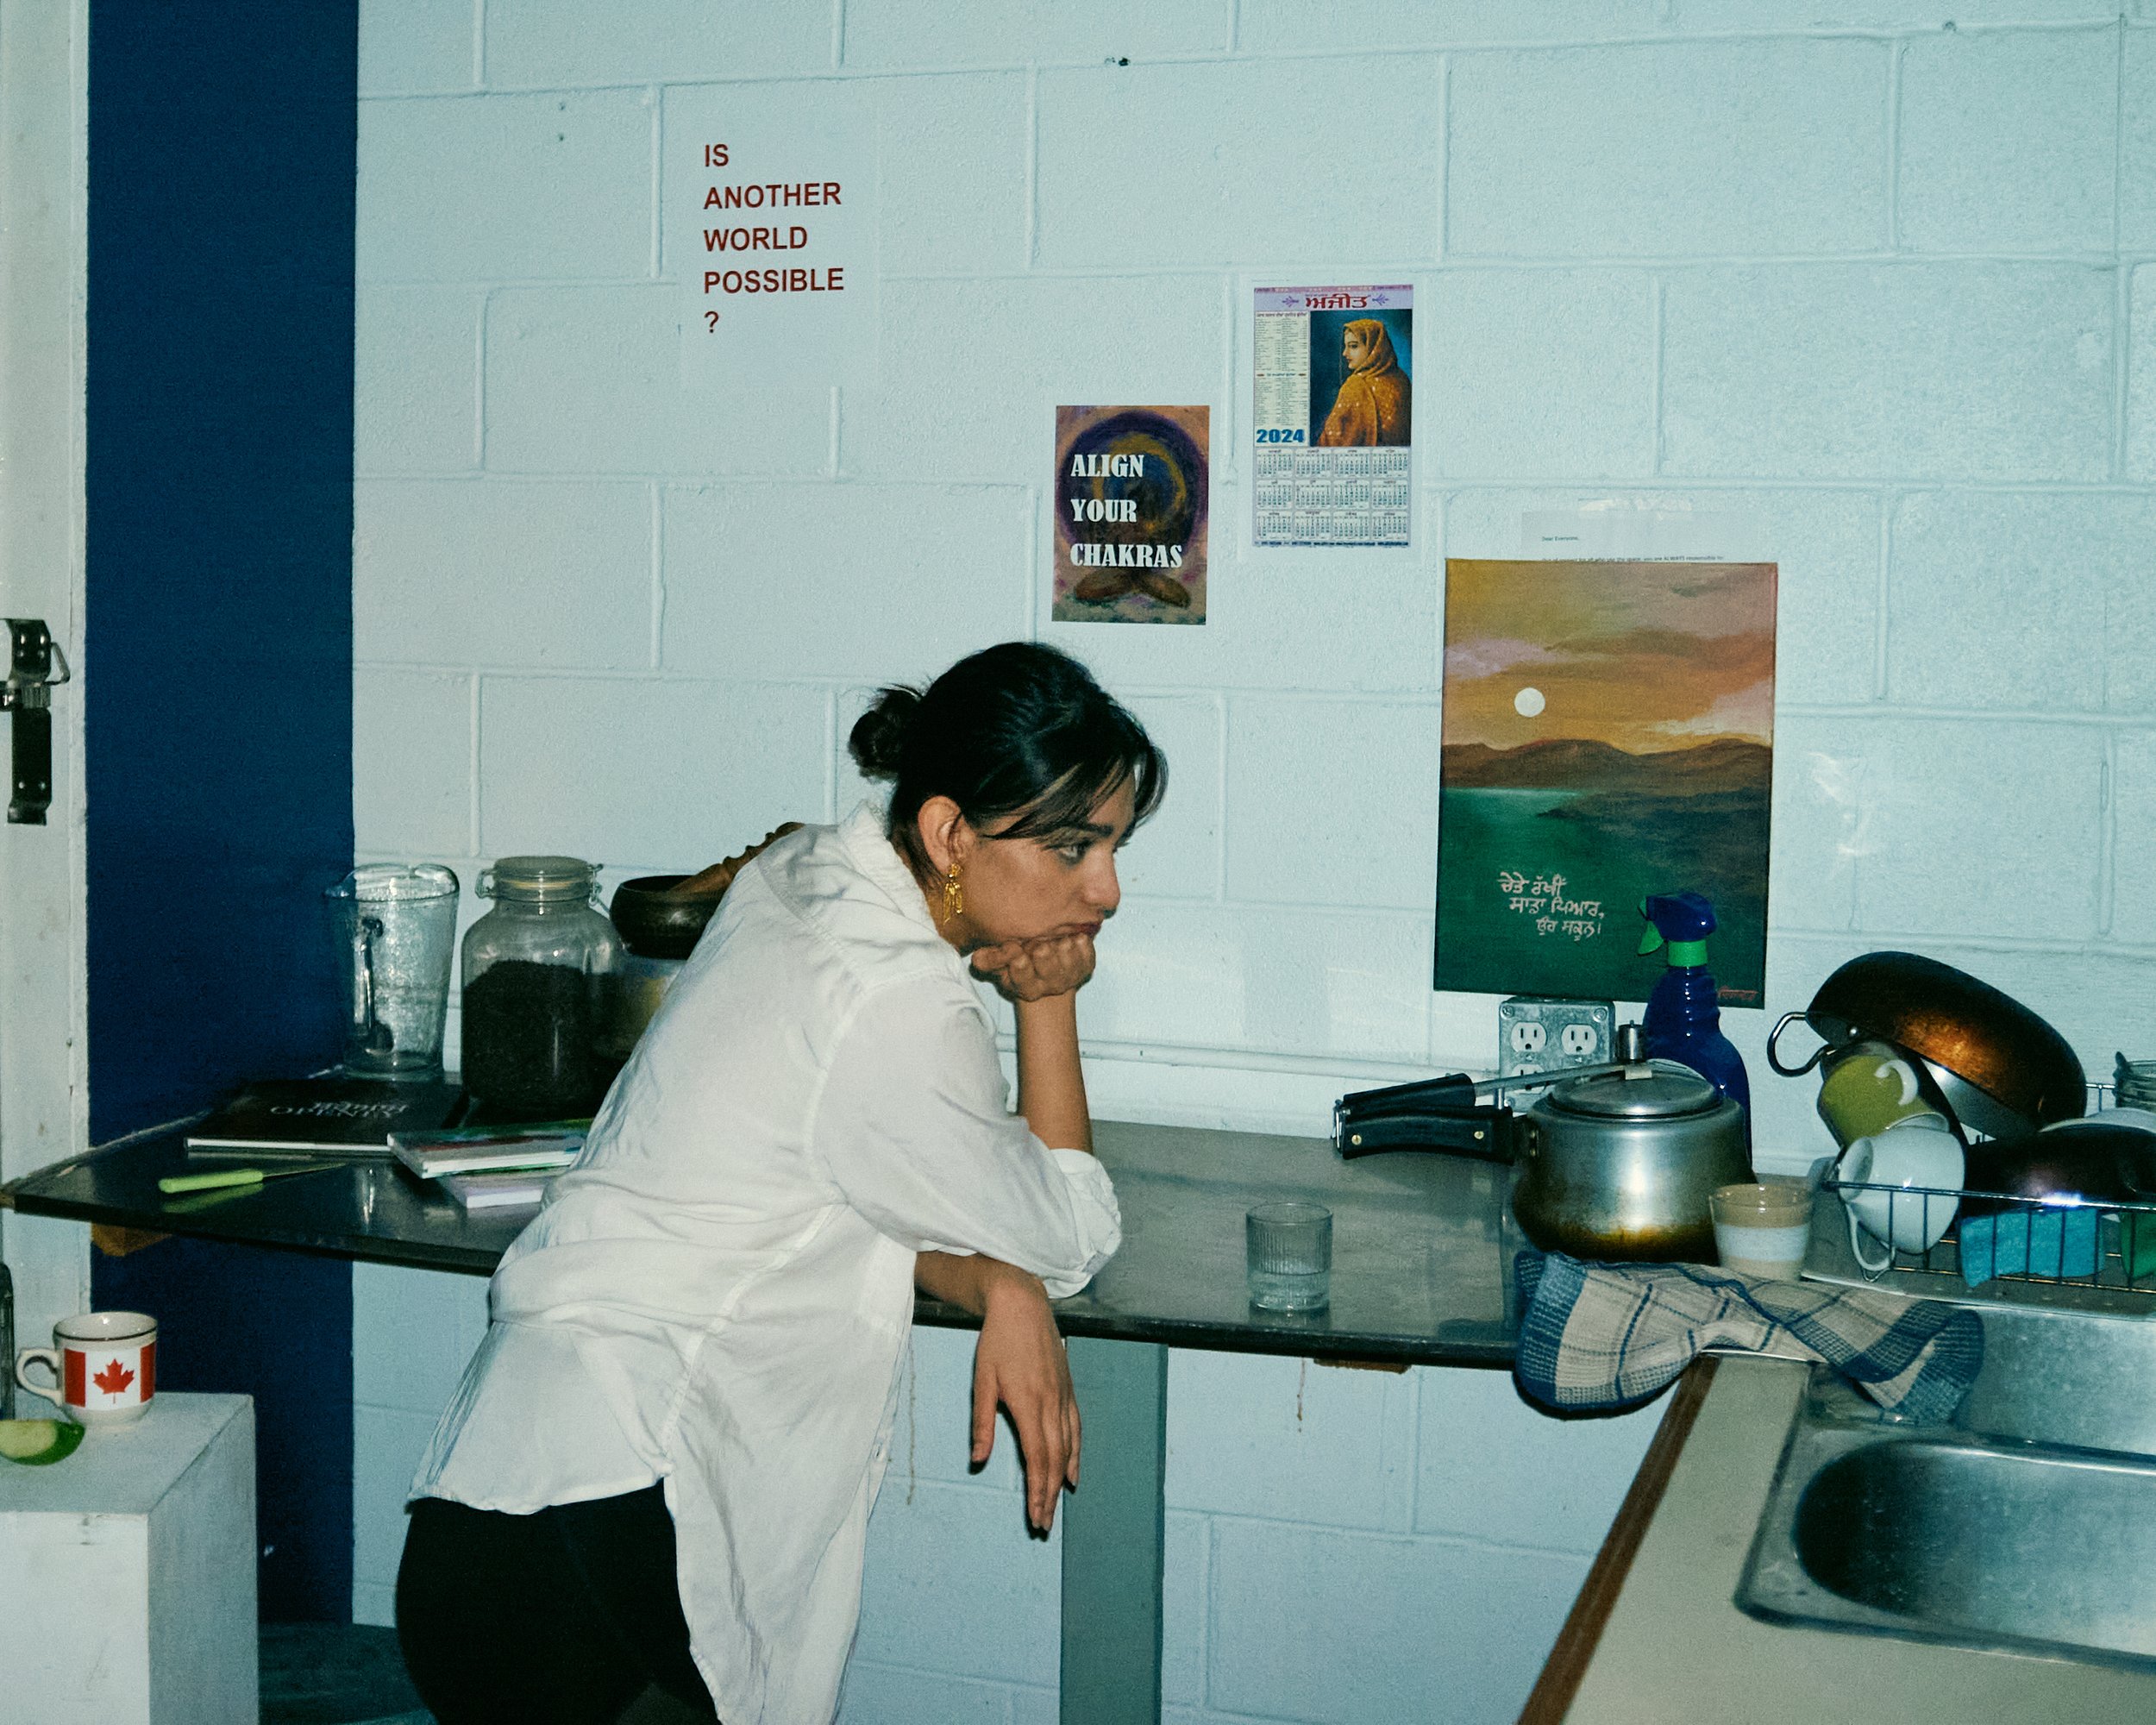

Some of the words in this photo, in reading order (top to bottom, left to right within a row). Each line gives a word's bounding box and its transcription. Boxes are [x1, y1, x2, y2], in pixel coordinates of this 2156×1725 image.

[705, 143, 730, 167] IS
[703, 182, 842, 210] ANOTHER
[703, 226, 808, 252] WORLD
[704, 267, 844, 294] POSSIBLE
[1305, 293, 1369, 309] ਅਜੀਤ
[704, 310, 719, 334] ?
[1256, 429, 1305, 443] 2024
[1070, 454, 1144, 478] ALIGN
[1070, 499, 1138, 523] YOUR
[1069, 543, 1183, 568] CHAKRAS
[1497, 871, 1530, 894] ਚੇਤੇ
